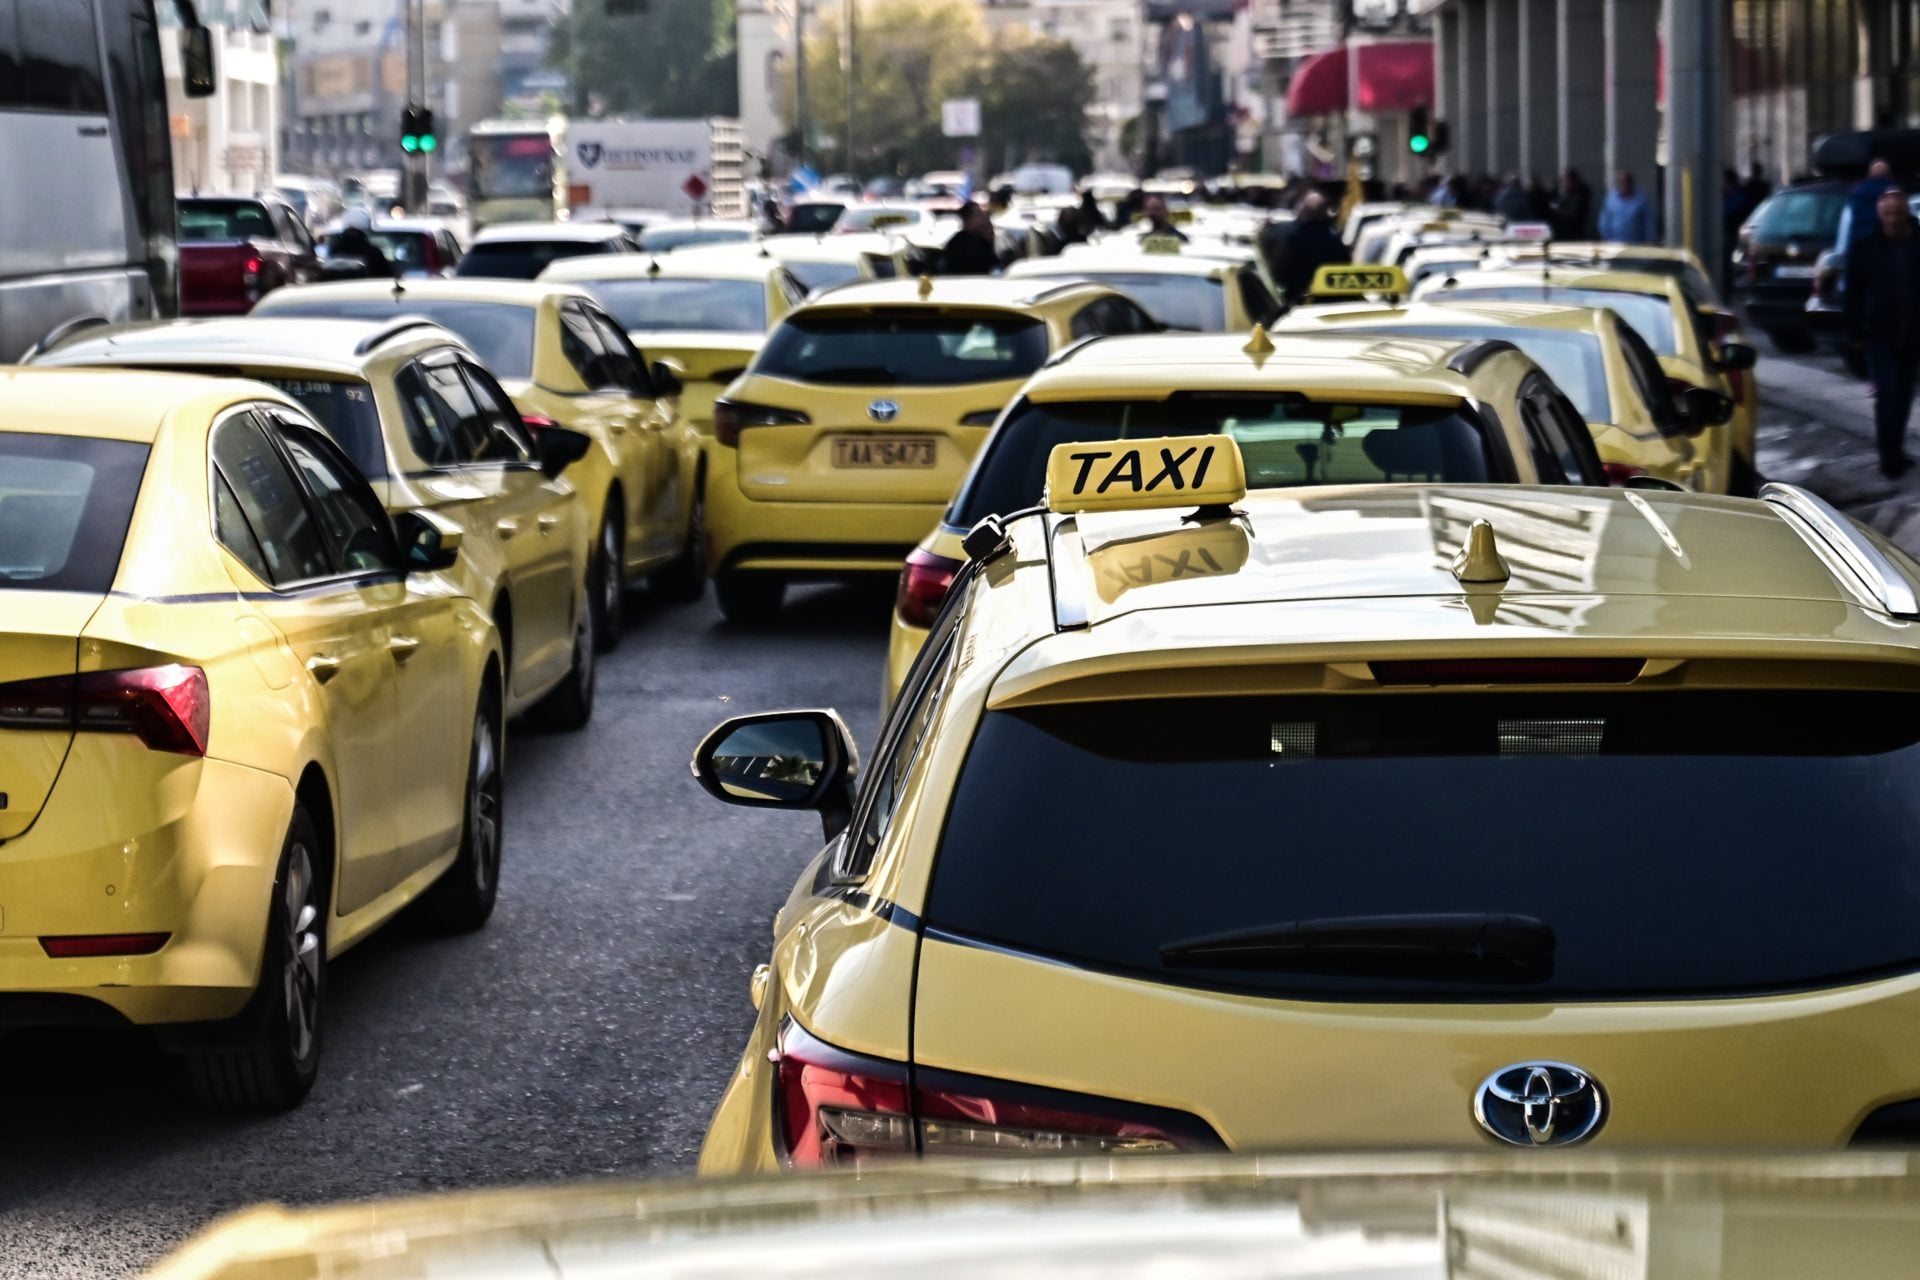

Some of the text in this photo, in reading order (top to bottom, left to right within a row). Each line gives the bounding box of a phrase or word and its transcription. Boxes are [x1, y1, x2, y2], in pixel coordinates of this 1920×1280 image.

[1331, 274, 1390, 289] TAXI
[345, 388, 366, 402] 92
[1070, 446, 1215, 495] TAXI
